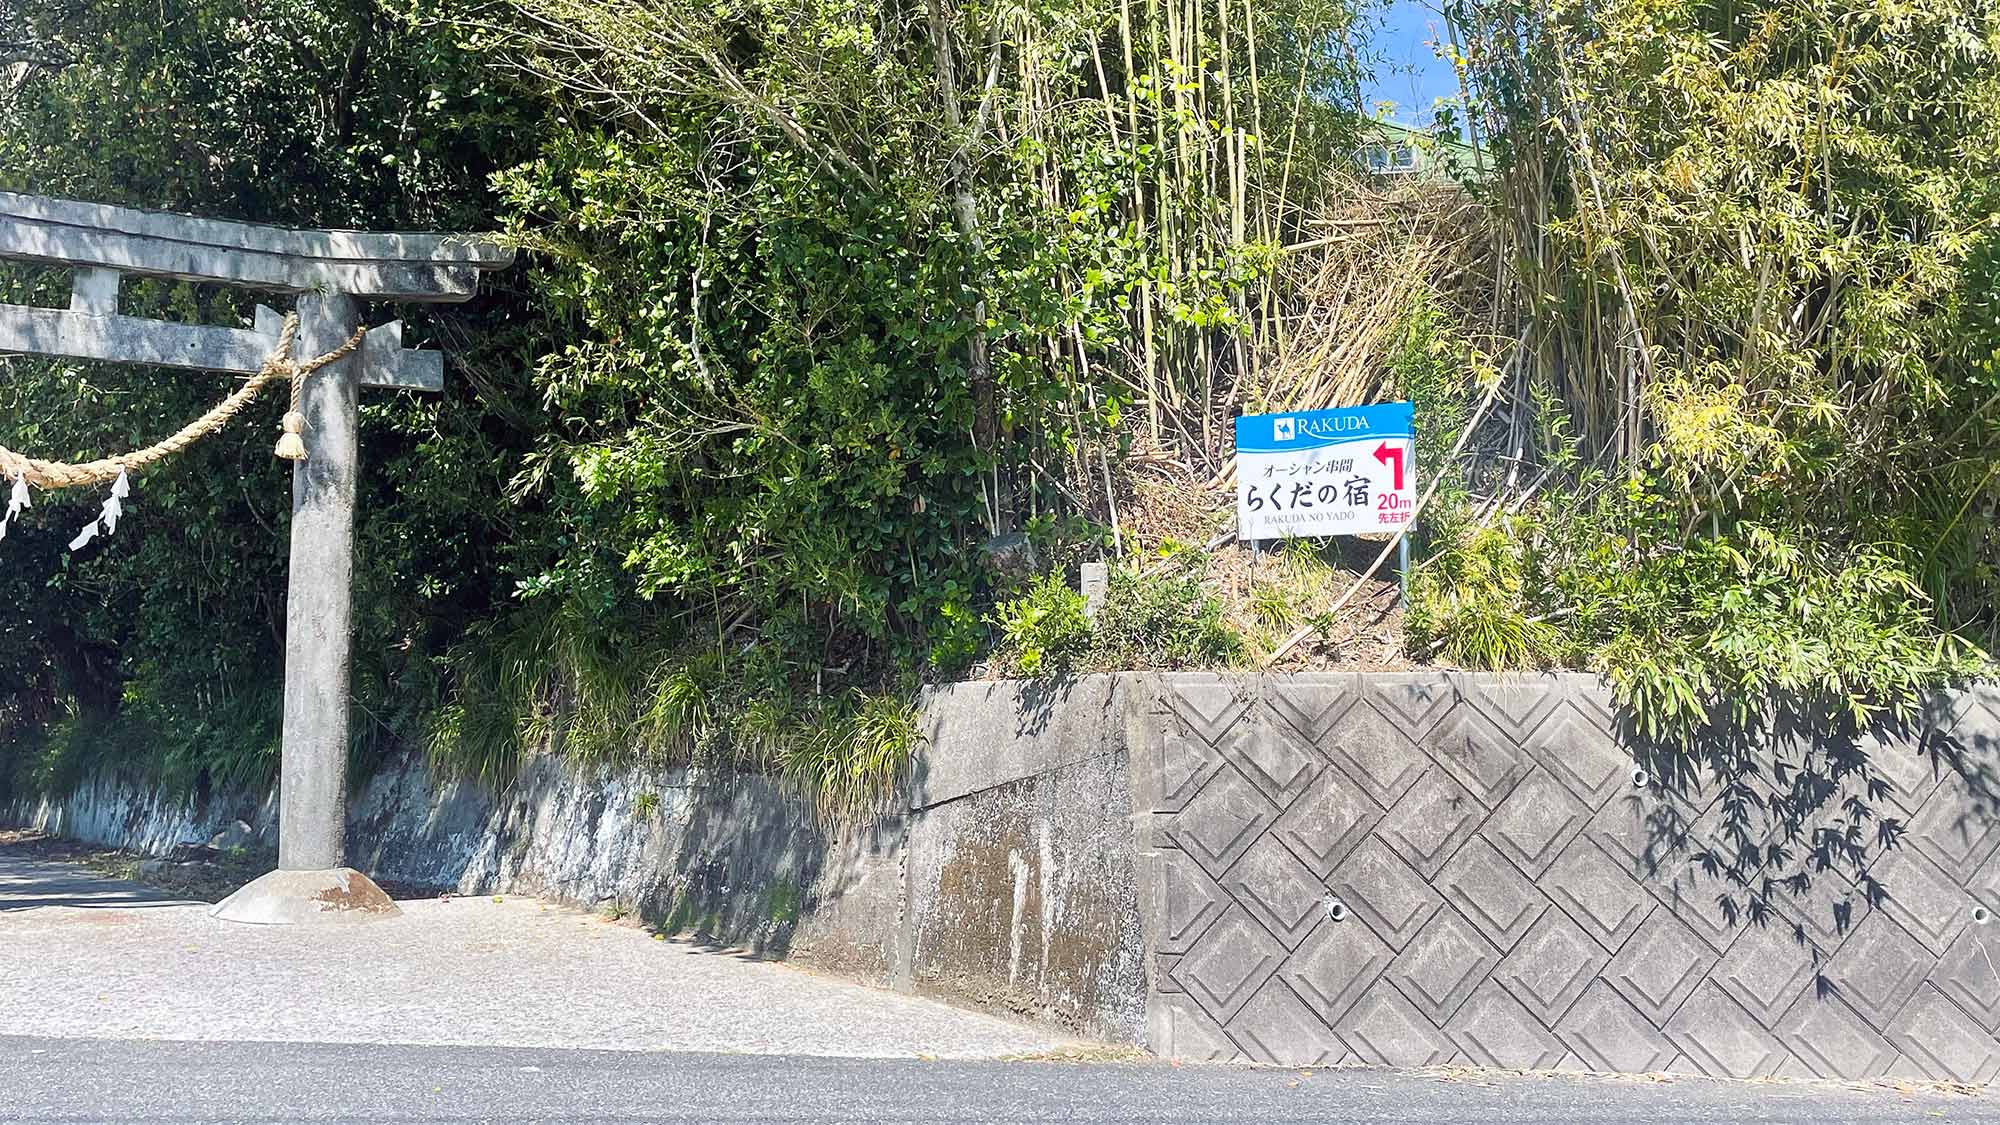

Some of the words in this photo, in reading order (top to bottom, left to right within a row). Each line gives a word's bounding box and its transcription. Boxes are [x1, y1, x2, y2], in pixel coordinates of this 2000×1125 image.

[1297, 415, 1370, 435] RAKUDA
[1263, 458, 1354, 478] オーシャン串間
[1247, 474, 1372, 513] らくだの宿
[1377, 493, 1412, 510] 20m
[1264, 514, 1306, 525] RAKUDA
[1309, 513, 1324, 522] NO
[1326, 511, 1355, 521] YADO
[1378, 511, 1411, 524] 先左折
